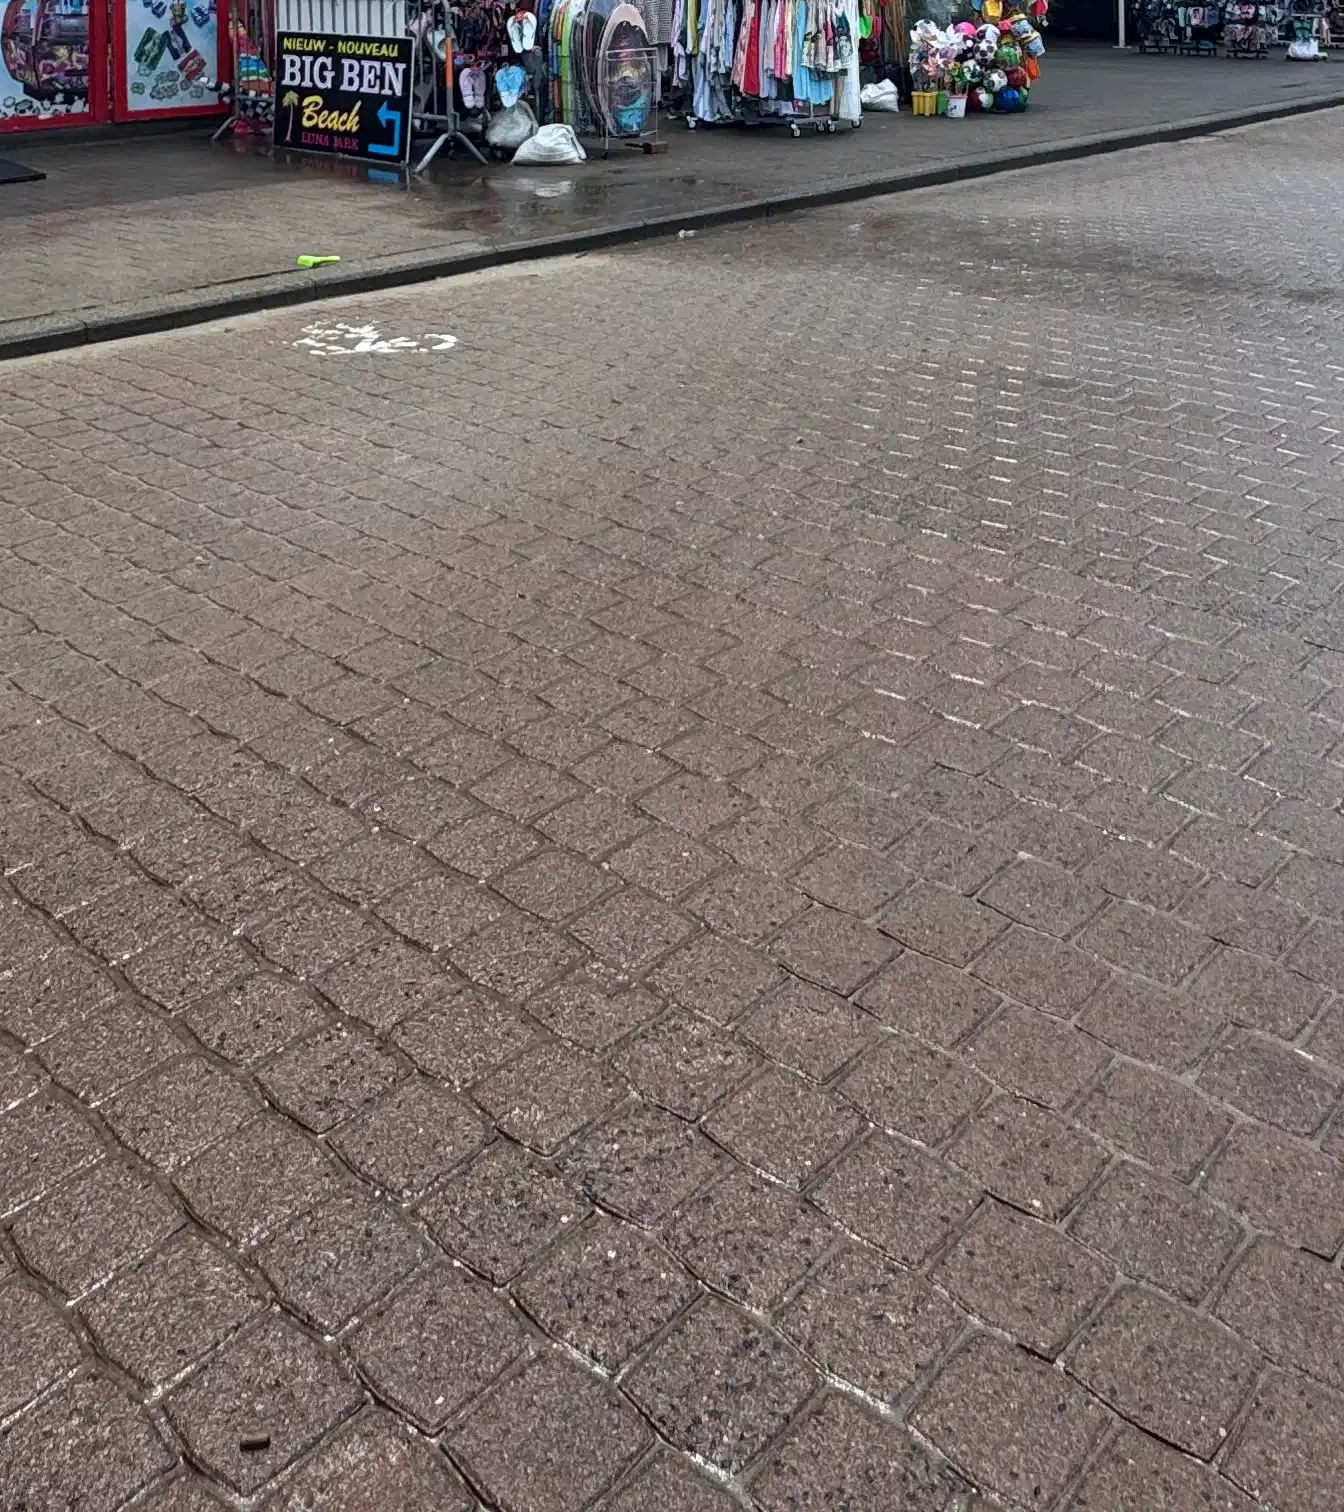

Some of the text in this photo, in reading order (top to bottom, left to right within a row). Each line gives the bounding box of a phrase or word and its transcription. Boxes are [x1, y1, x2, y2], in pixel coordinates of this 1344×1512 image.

[283, 37, 327, 53] NIEUW
[337, 40, 399, 58] NOUVEAU
[281, 54, 406, 97] BIG BEN
[301, 95, 362, 133] Beach
[301, 131, 330, 147] LUNA
